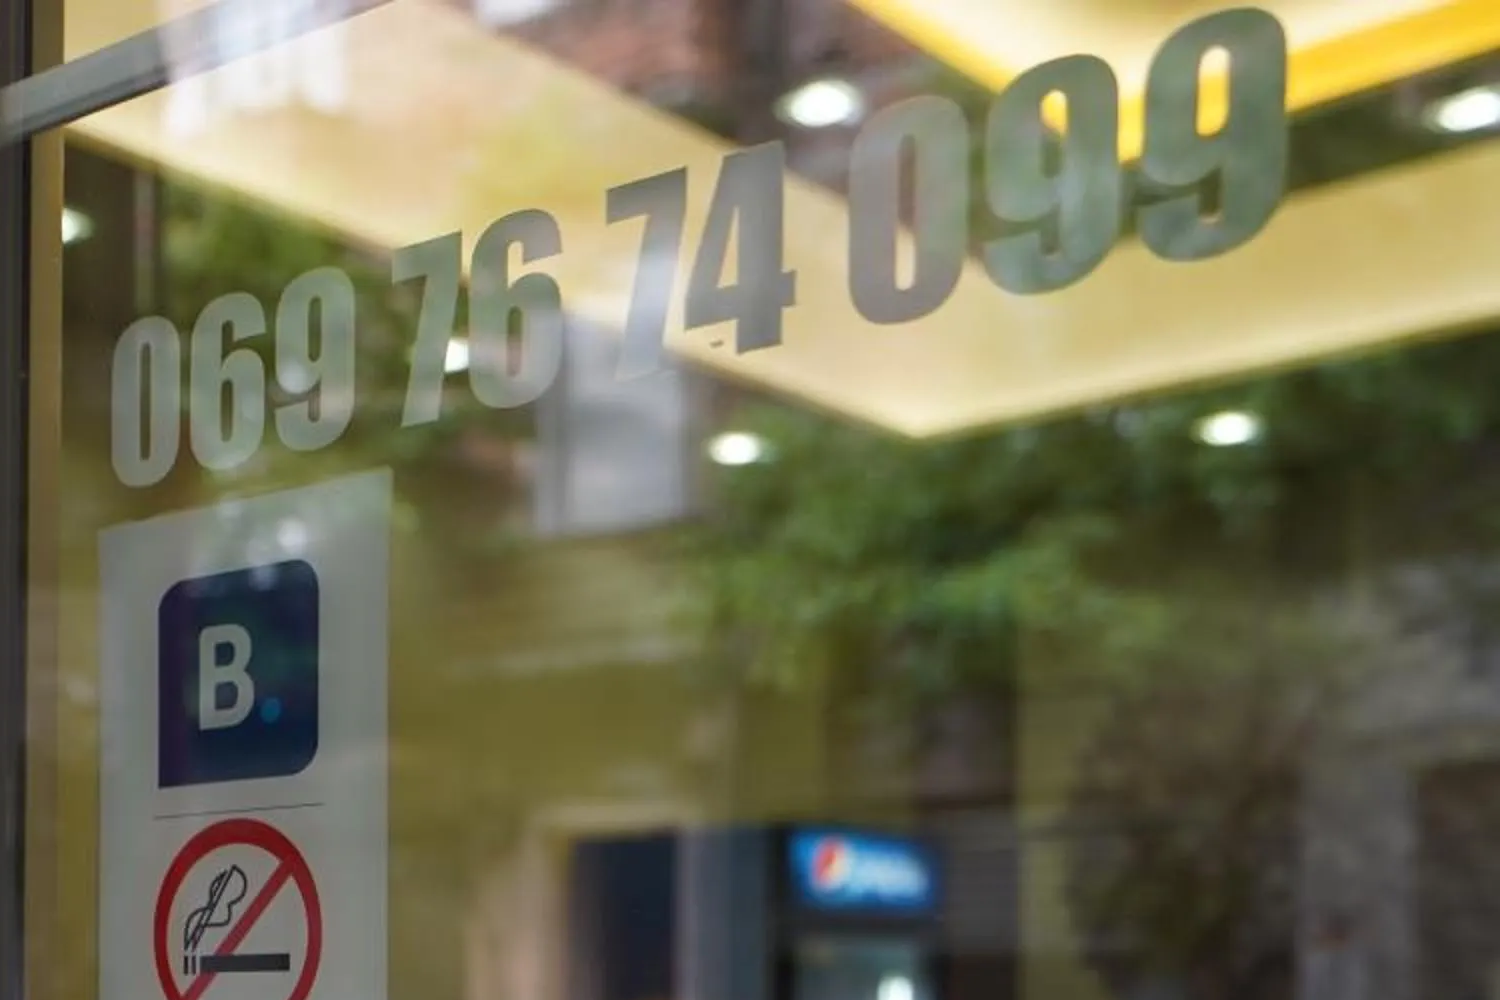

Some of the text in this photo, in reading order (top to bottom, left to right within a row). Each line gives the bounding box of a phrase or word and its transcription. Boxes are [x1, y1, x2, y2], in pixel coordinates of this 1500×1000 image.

[110, 6, 1288, 488] 069 76 74 099
